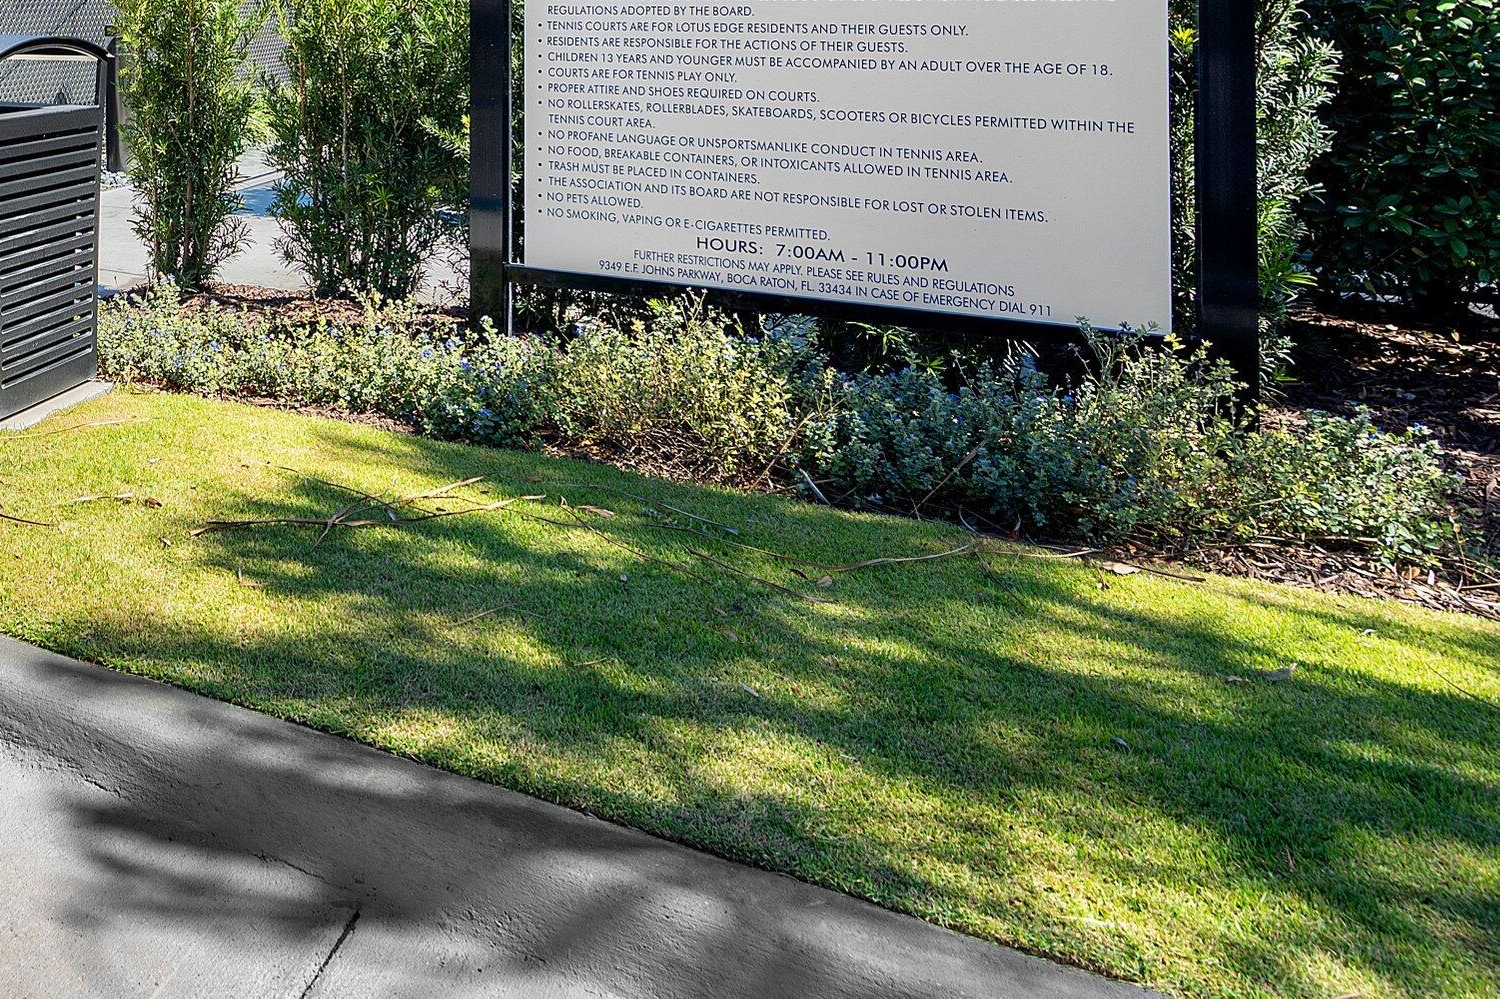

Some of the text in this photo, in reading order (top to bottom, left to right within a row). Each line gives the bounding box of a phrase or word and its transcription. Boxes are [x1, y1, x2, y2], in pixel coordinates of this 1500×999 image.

[547, 4, 755, 17] REGULATIONS ADOPTED BY THE BOARD.
[546, 20, 969, 37] TENNIS COURTS ARE FOR LOTUS EDGE RESIDENTS AND THEIR GUESTS ONLY.
[547, 82, 820, 103] PROPER ATTIRE AND SHOES REQUIRED ON COURTS.
[547, 98, 1135, 134] NO ROLLERSKATES, ROLLERBLADES, SKATEBOARDS, SCOOTERS OR BICYCLES PERMITTED WITHIN THE
[548, 113, 656, 129] TENNIS COURT AREA.
[547, 129, 983, 164] NO PROFANE LANGUAGE OR UNSPORTSMANLIKE CONDUCT IN TENNIS AREA.
[548, 160, 760, 185] TRASH MUST BE PLACED IN CONTAINERS.
[546, 191, 644, 209] NO PETS ALLOWED.
[547, 175, 1049, 223] THE ASSOCIATION AND ITS BOARD ARE NOT RESPONSIBLE FOR LOST OR STOLEN ITEMS.
[546, 207, 831, 241] NO SMOKING, VAPING OR E-CIGARETTES PERMITTED.
[696, 236, 763, 256] HOURS:
[775, 243, 846, 263] 7:00AM
[866, 251, 949, 273] 11:00PM
[598, 259, 623, 272] 9349
[641, 263, 676, 278] JOHNS
[677, 267, 725, 285] PARKWAY,
[726, 272, 758, 286] BOCA
[759, 275, 798, 292] RATON,
[800, 279, 815, 292] FL.
[817, 281, 853, 296] 33434
[855, 285, 868, 298] IN
[870, 287, 900, 301] CASE
[902, 290, 920, 303] OF
[922, 292, 996, 311] EMERGENCY
[998, 300, 1027, 315] DIAL
[1028, 303, 1051, 317] 911
[633, 249, 1015, 298] FURTHER RESTRICTIONS MAY APPLY. PLEASE SEE RULES AND REGULATIONS
